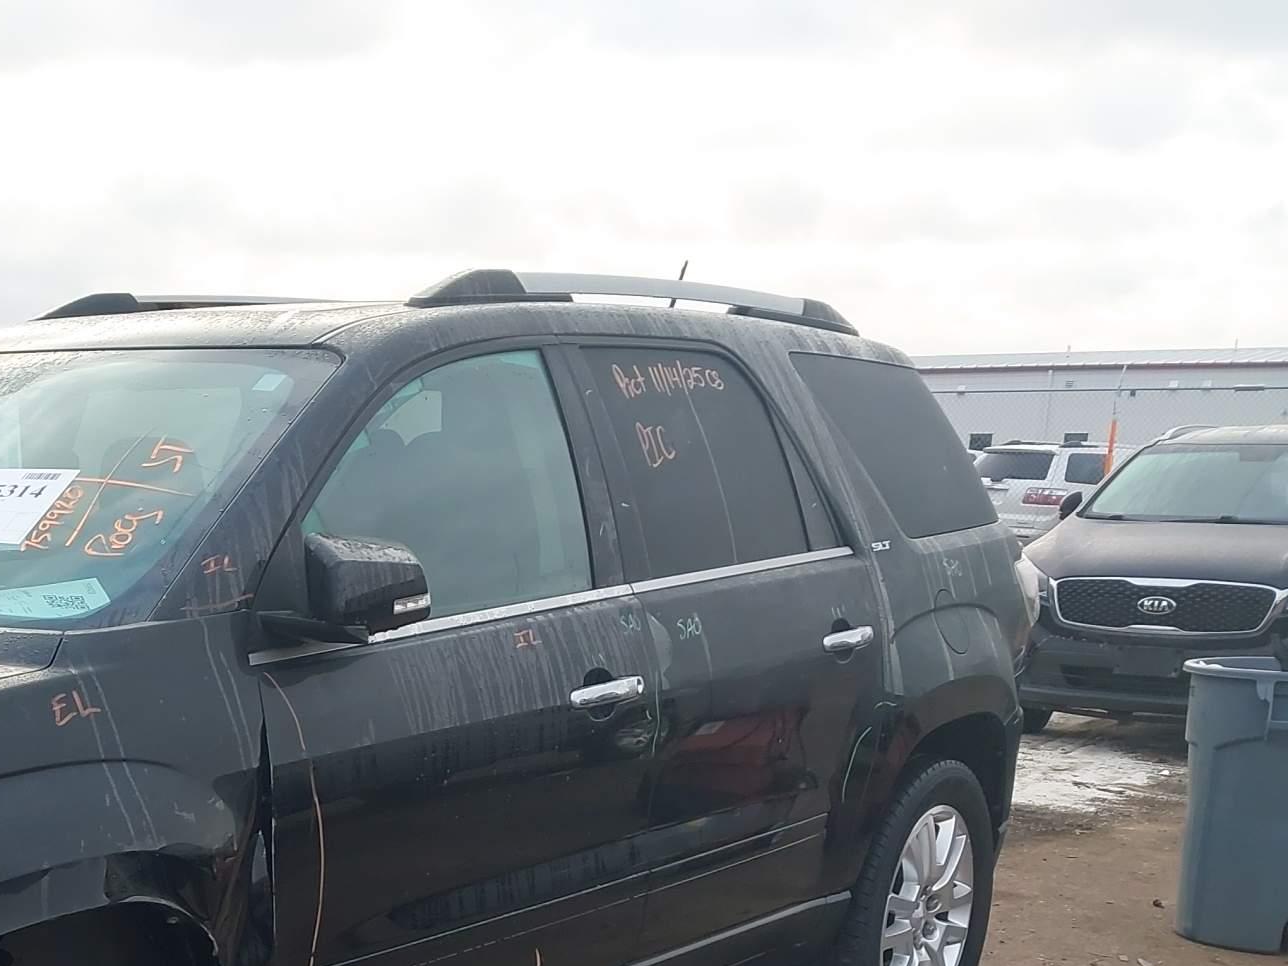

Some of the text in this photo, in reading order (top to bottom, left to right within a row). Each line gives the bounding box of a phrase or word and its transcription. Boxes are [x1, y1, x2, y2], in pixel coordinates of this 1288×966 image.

[872, 541, 890, 551] SLT
[1143, 600, 1169, 611] KIA
[52, 690, 102, 727] EL
